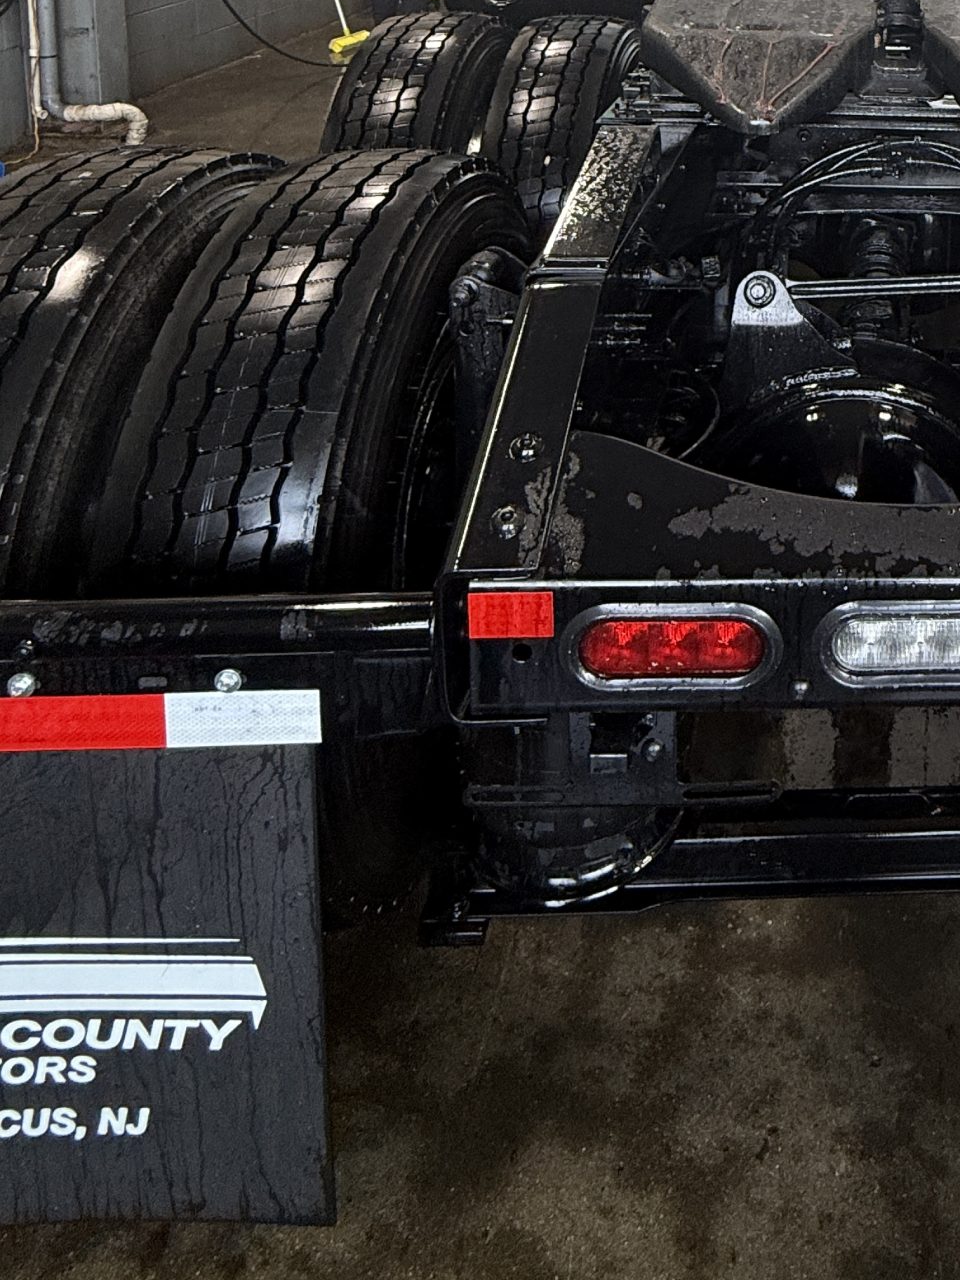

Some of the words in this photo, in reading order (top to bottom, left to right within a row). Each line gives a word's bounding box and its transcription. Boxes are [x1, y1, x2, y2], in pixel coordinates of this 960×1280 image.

[0, 1019, 243, 1051] COUNTY
[0, 1055, 98, 1084] ORS
[97, 1107, 150, 1135] NJ
